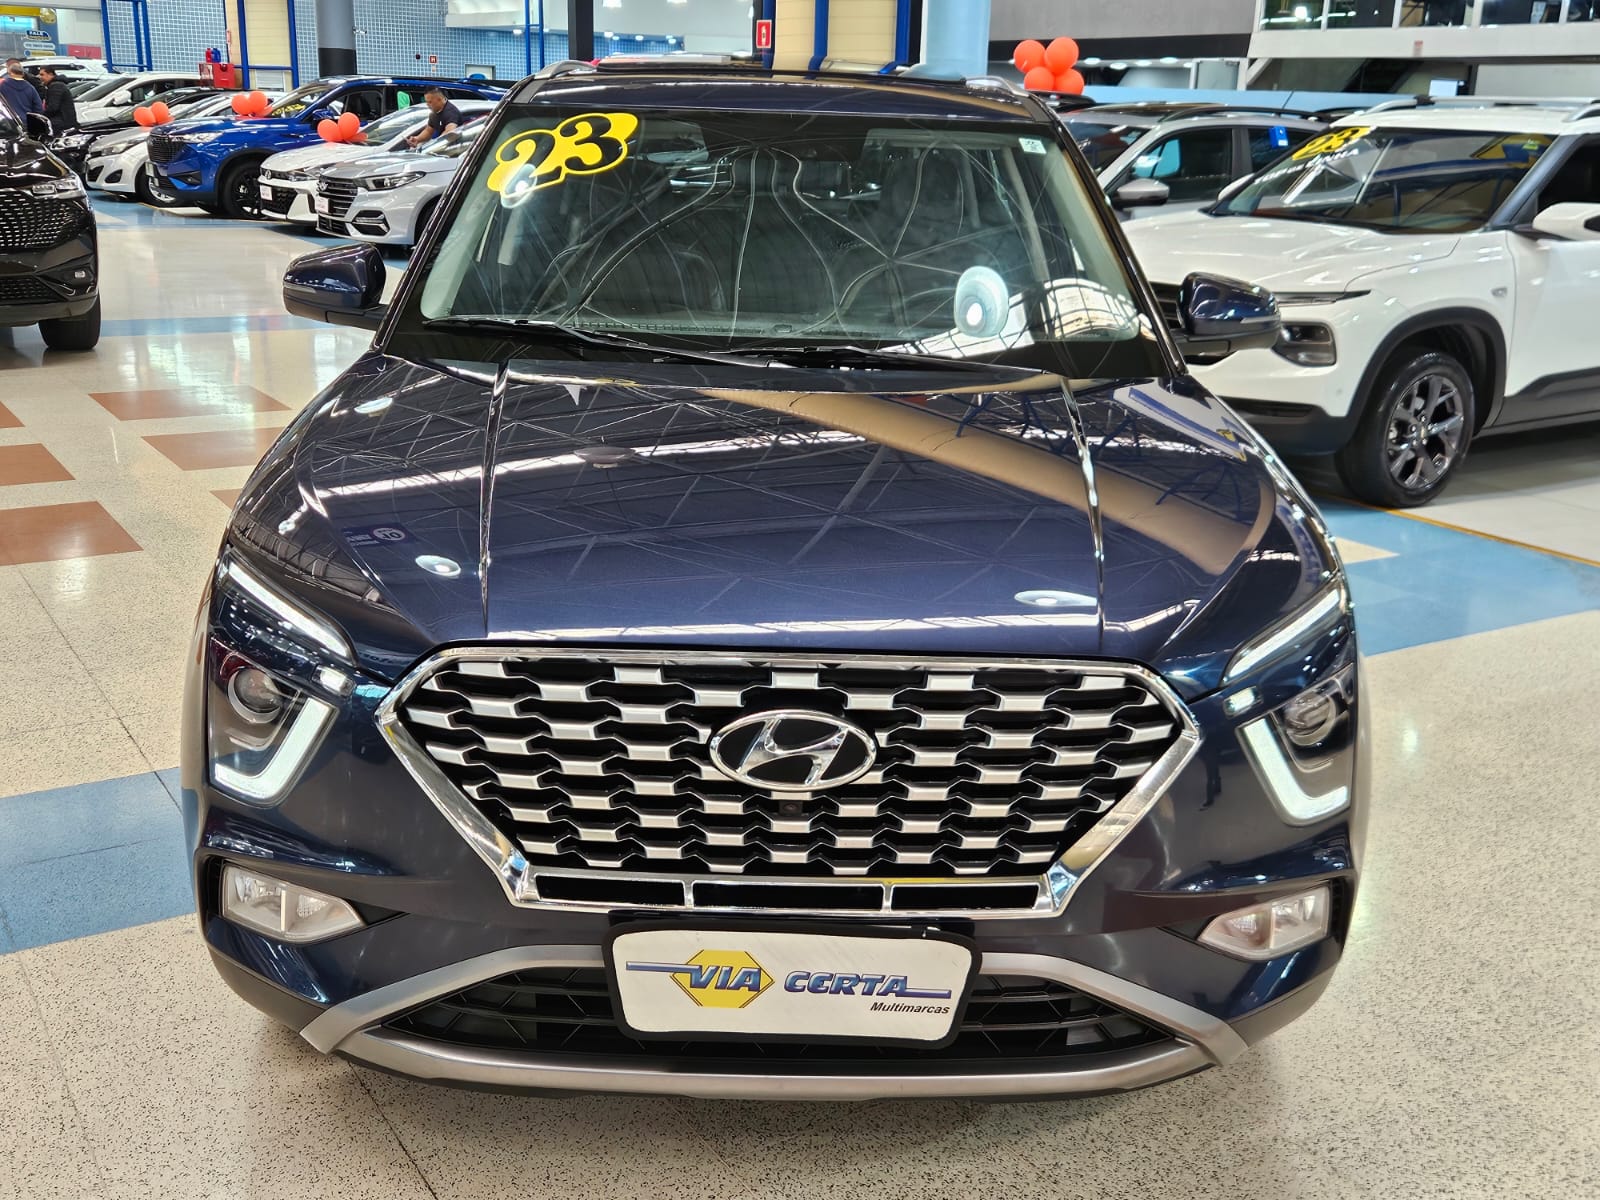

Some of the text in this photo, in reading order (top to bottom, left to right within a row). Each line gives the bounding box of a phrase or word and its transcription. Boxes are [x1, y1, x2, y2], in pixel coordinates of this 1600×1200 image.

[499, 114, 624, 196] 23
[688, 965, 910, 999] VIA CERTA
[870, 1001, 951, 1015] Multimarcas
